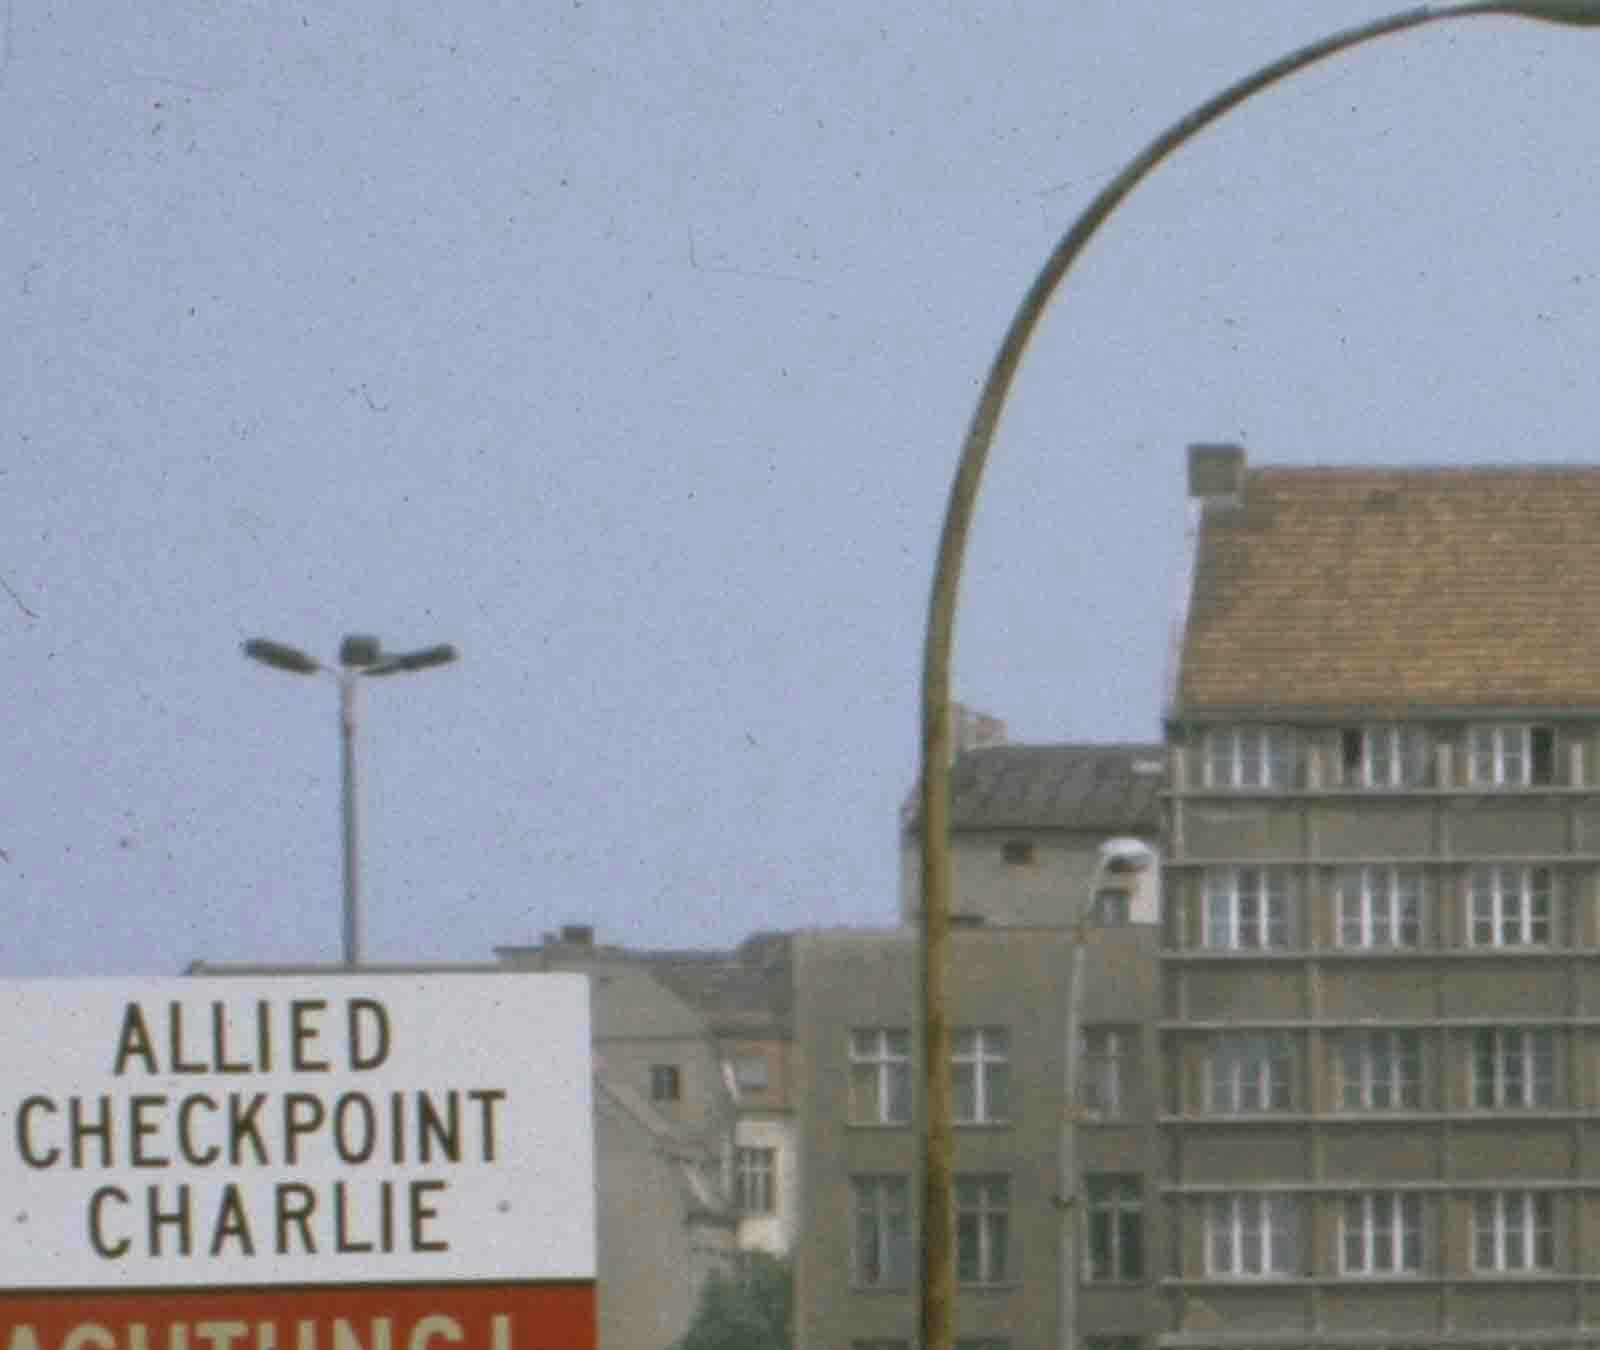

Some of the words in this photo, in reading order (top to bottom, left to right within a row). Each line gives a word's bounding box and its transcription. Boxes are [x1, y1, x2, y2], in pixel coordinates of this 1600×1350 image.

[114, 998, 391, 1076] ALLIED
[16, 1090, 505, 1169] CHECKPOINT
[88, 1180, 449, 1259] CHARLIE
